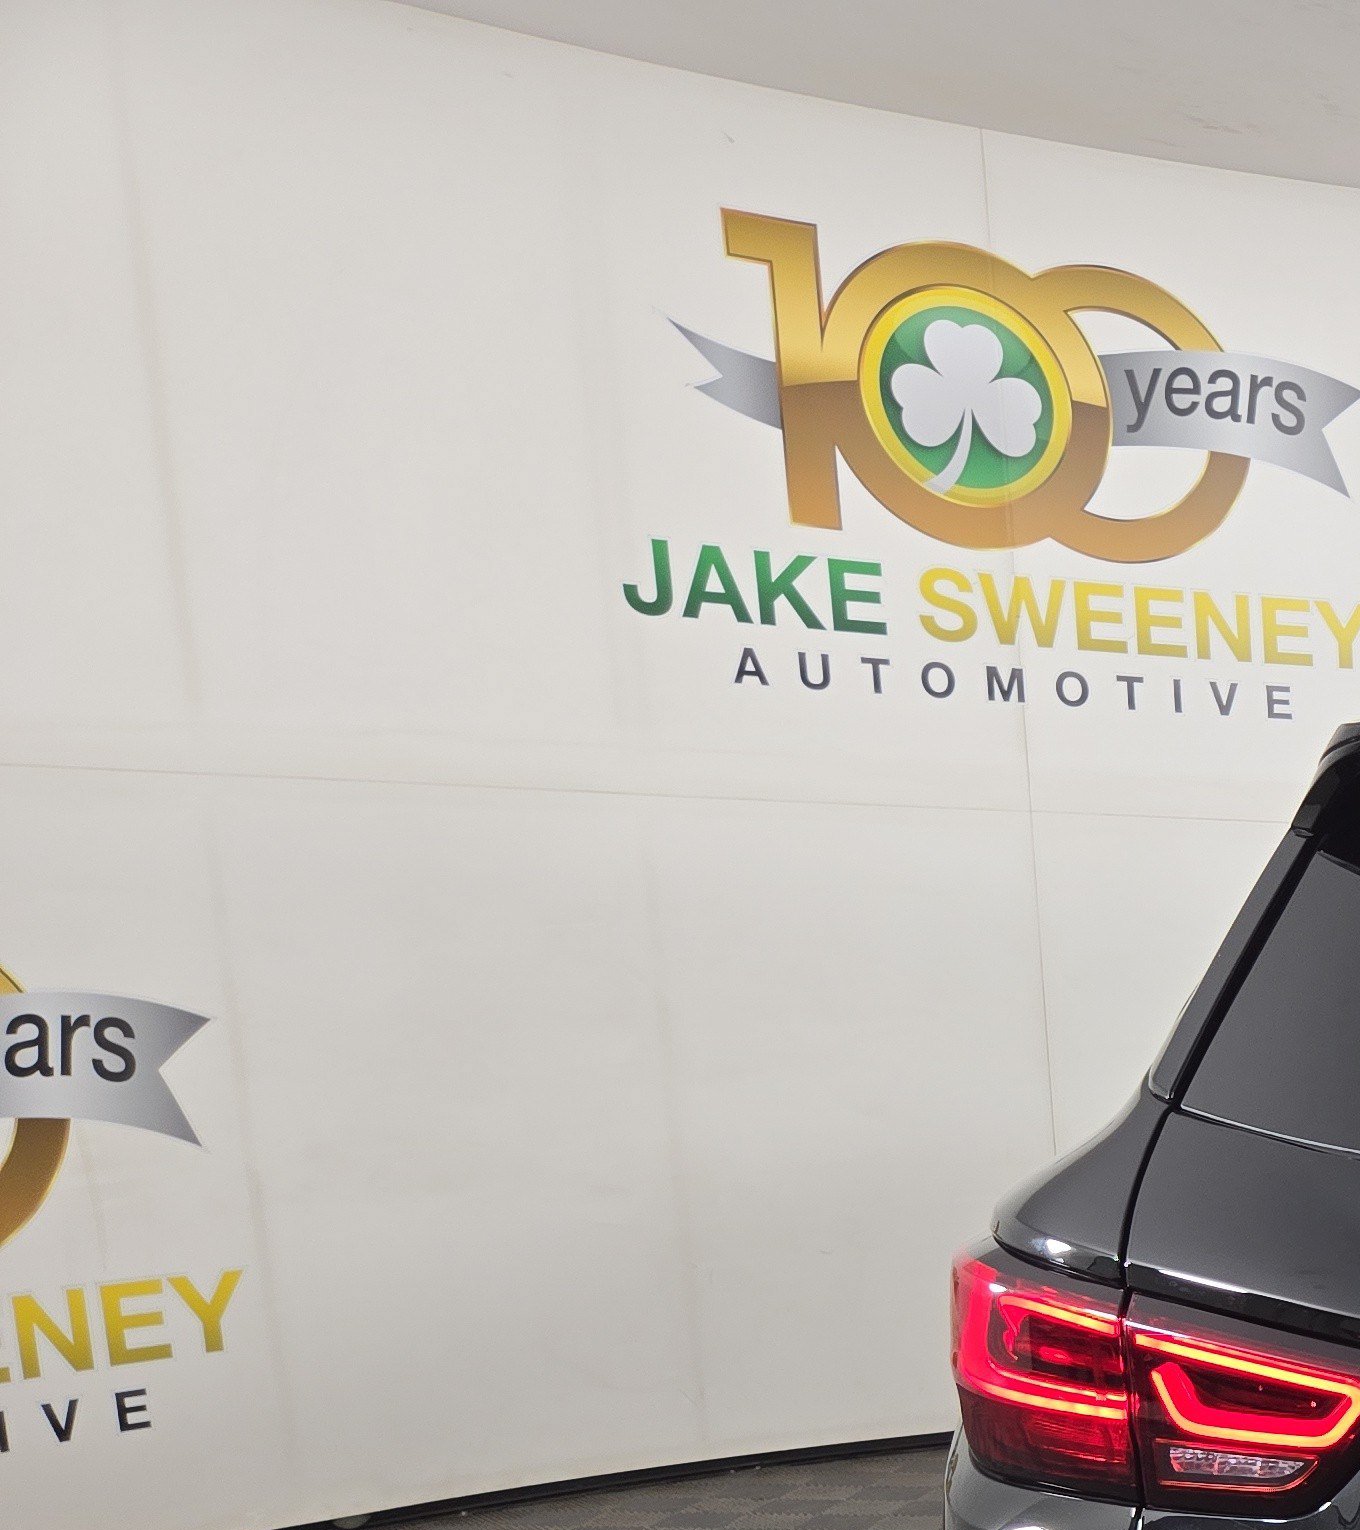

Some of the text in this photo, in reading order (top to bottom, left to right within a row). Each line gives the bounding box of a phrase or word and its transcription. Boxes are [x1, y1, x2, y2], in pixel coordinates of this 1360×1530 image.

[720, 207, 1251, 563] 100
[1124, 363, 1308, 436] years
[622, 537, 888, 635] JAKE
[734, 647, 1294, 720] AUTOMOTIVE
[0, 1269, 242, 1385] NEY
